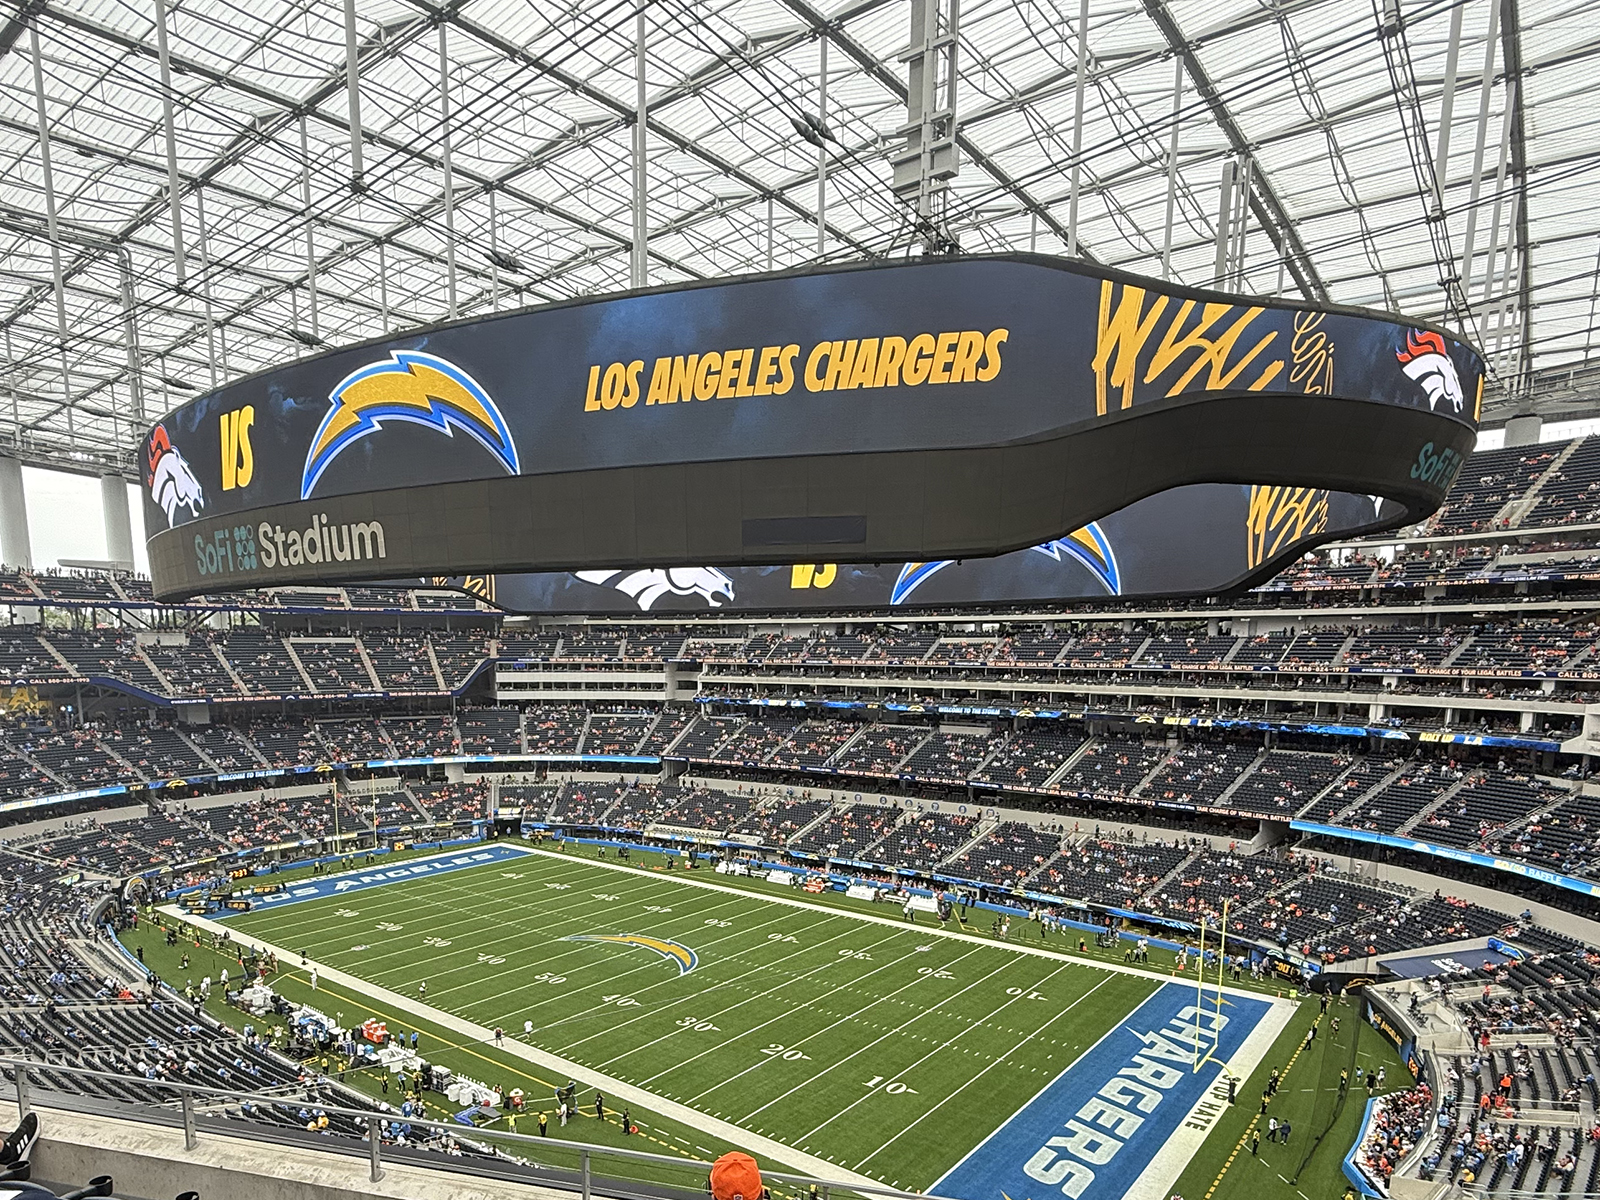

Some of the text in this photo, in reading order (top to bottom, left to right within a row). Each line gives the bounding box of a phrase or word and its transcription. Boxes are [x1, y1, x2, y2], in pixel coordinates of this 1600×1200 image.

[585, 328, 1009, 412] LOS ANGELES CHARGERS
[219, 404, 255, 492] VS
[194, 512, 386, 576] SoFi Stadium
[938, 706, 963, 714] WELCOME
[1418, 732, 1440, 743] BOLT
[1463, 735, 1482, 745] LA
[217, 773, 245, 782] WELCOME
[266, 769, 285, 777] STORM
[335, 852, 494, 892] ANGELES
[1528, 868, 1563, 885] RAFFLE
[534, 972, 567, 985] 50
[602, 994, 637, 1007] 40
[676, 1016, 714, 1031] 30
[760, 1043, 804, 1061] 20
[861, 1075, 909, 1094] 10
[1023, 1005, 1230, 1199] CHARGERS
[1185, 1101, 1222, 1132] HATE
